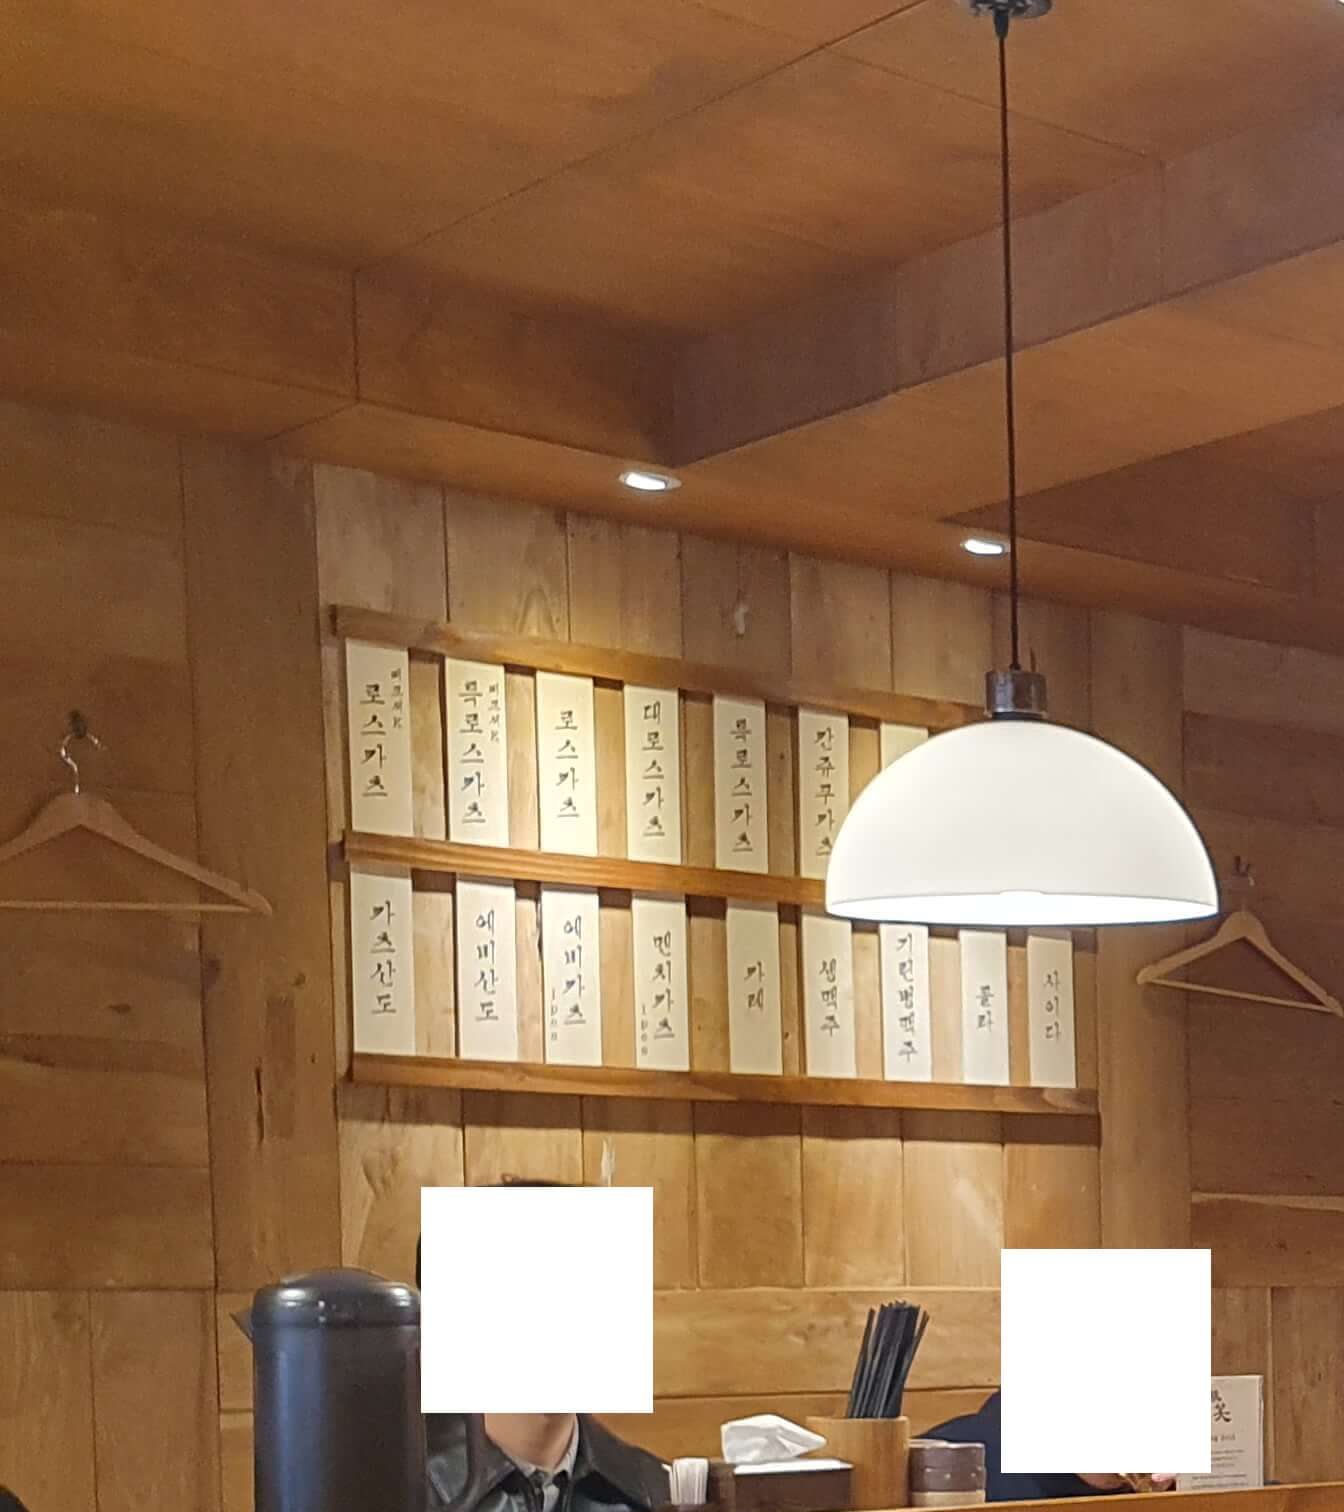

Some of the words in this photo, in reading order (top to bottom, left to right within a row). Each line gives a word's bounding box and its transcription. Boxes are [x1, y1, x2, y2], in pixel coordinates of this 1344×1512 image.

[474, 909, 499, 1021] 에비산도
[819, 958, 840, 1038] 생맥주
[896, 932, 918, 1063] 기린병맥주
[1044, 970, 1061, 1040] 사이다
[976, 985, 994, 1032] 콜라
